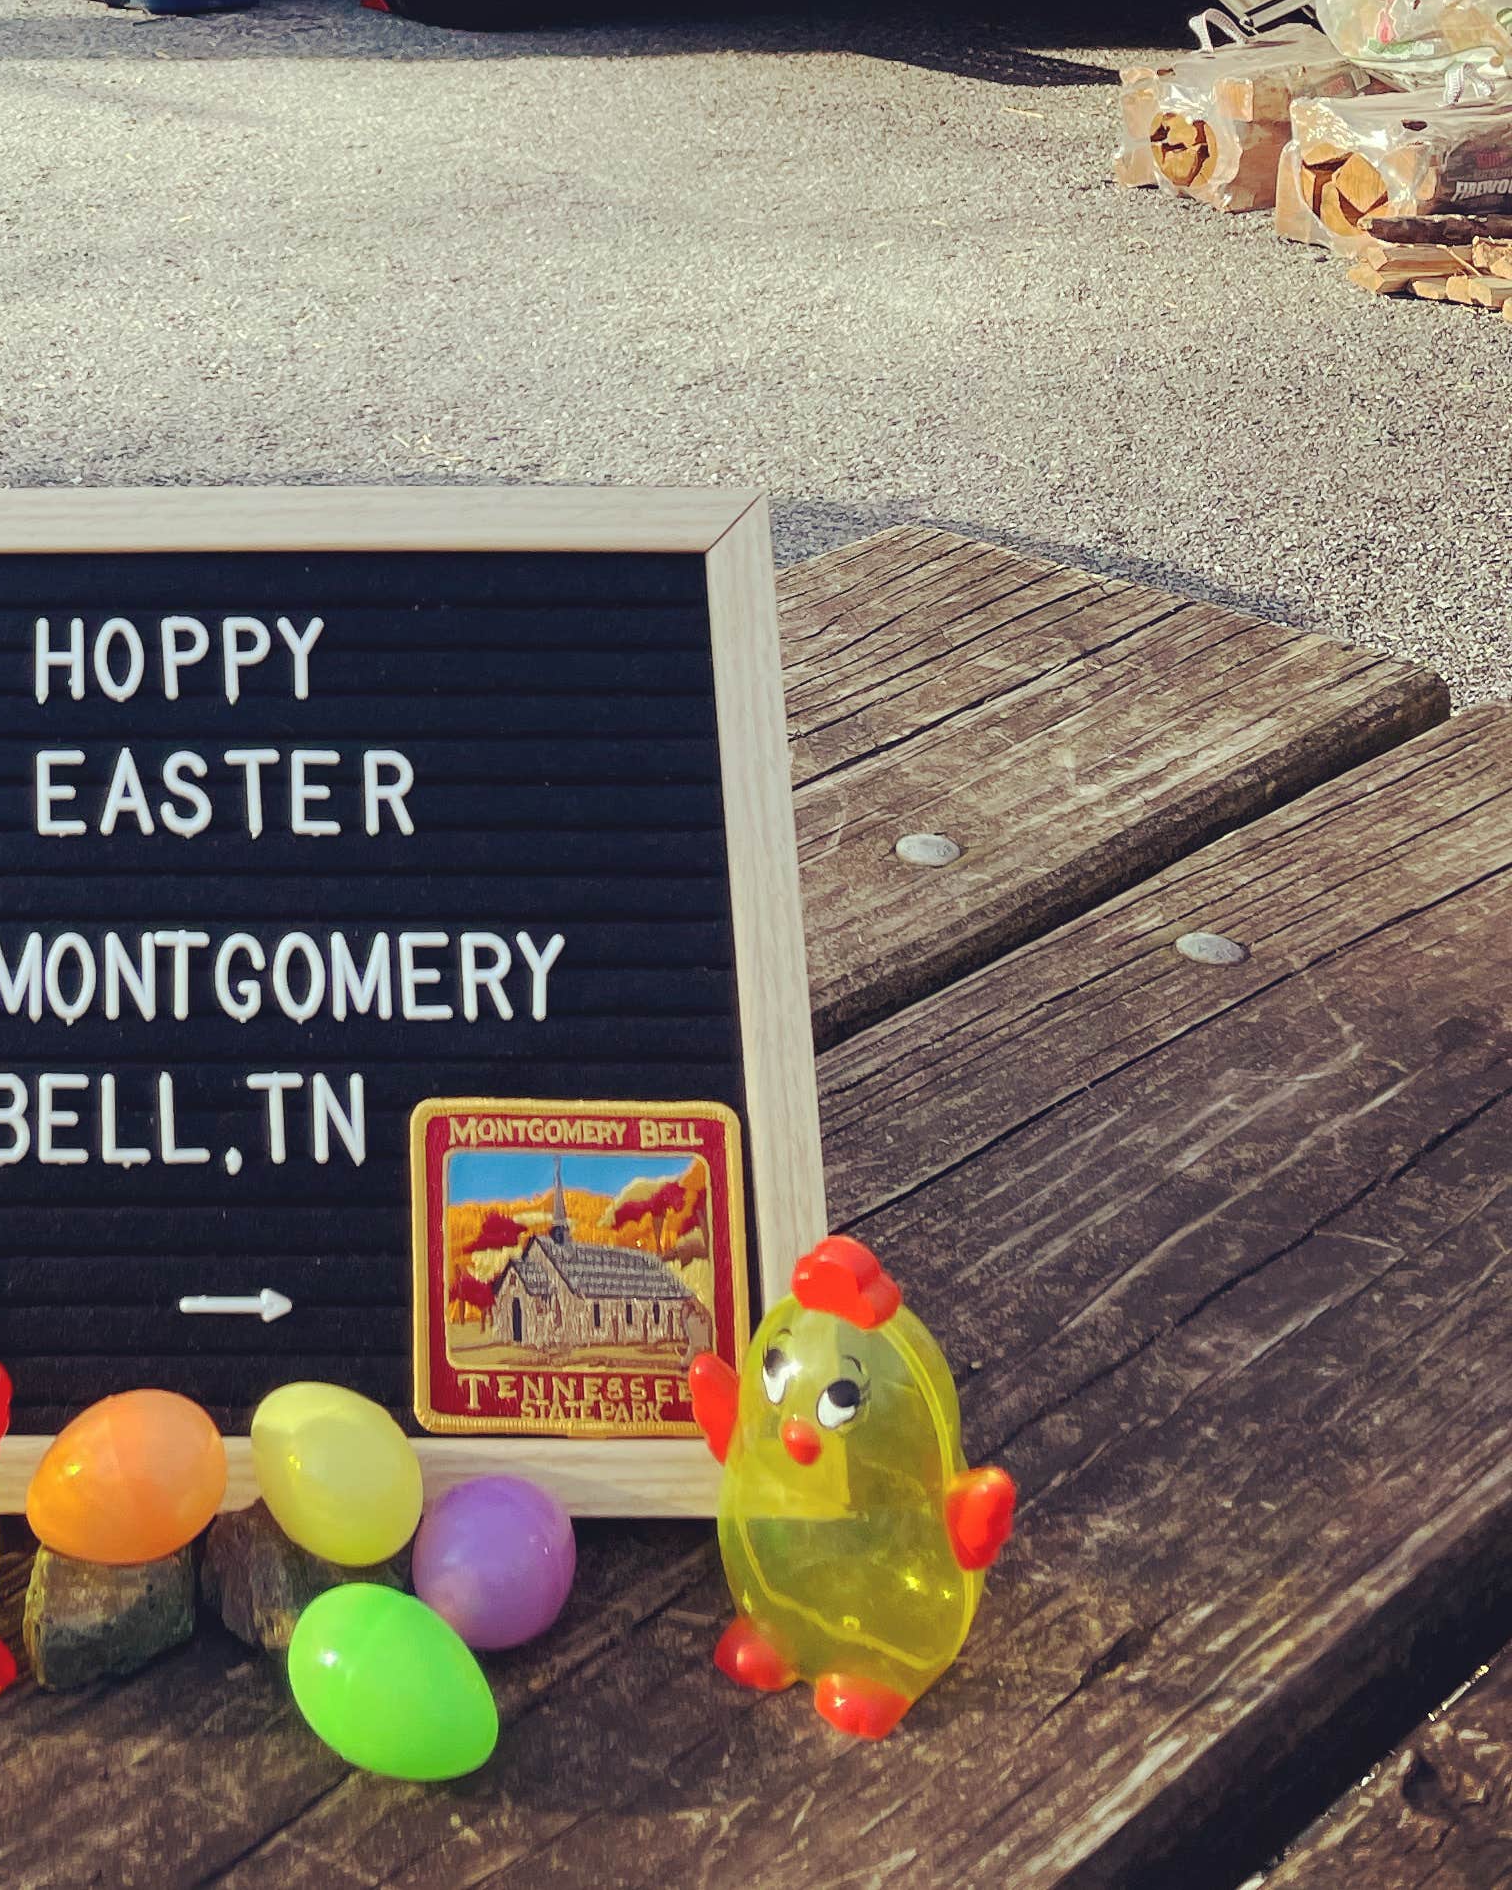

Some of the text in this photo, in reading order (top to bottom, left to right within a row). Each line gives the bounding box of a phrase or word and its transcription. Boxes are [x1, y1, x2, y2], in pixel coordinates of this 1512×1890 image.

[34, 615, 324, 705] HOPPY
[35, 746, 415, 839] EASTER
[448, 1116, 704, 1149] MONTGOMERY BELL
[456, 1374, 693, 1410] TENNESSEE
[520, 1397, 664, 1423] STATE PARK
